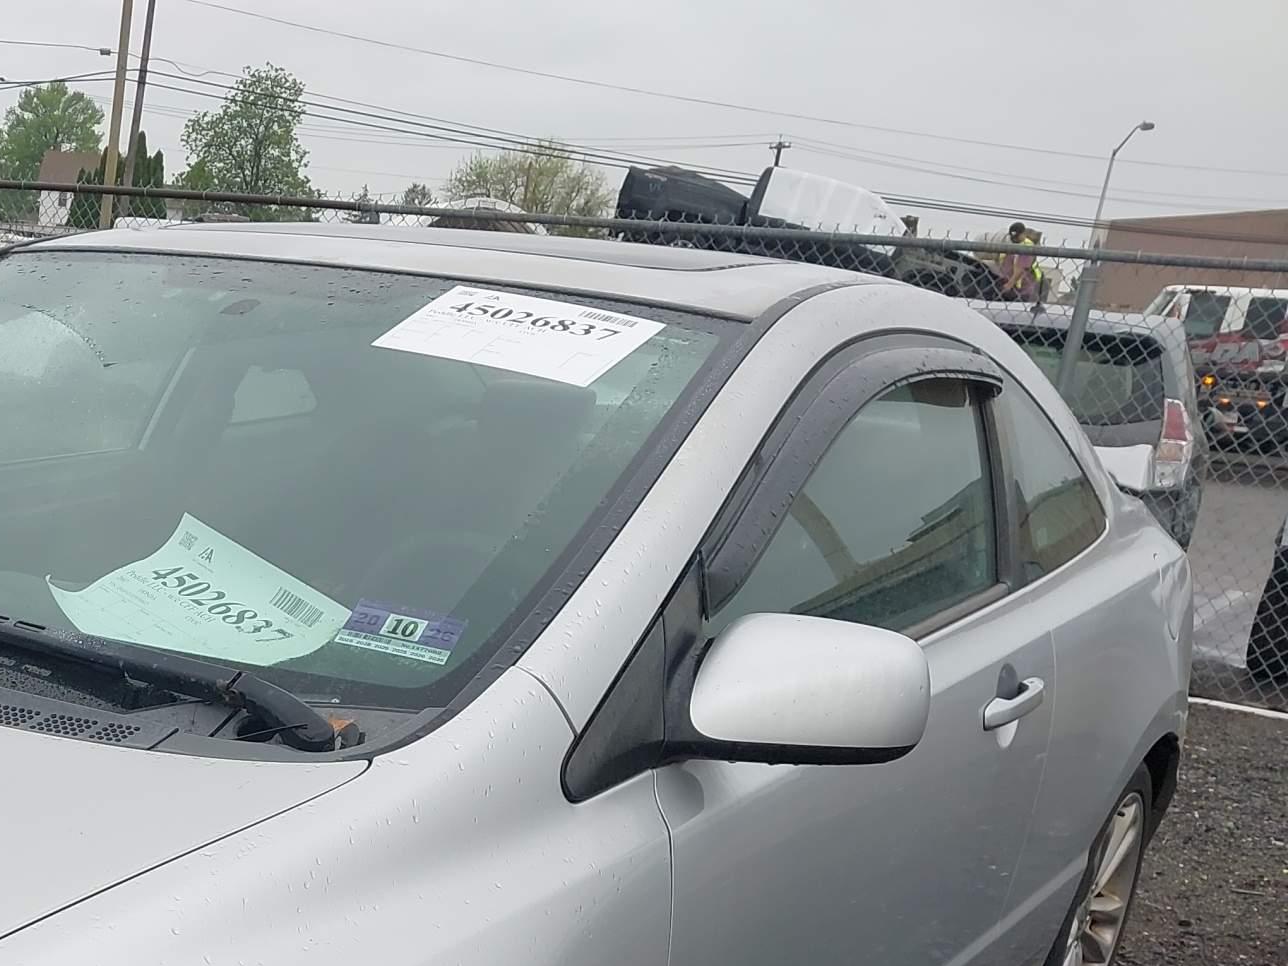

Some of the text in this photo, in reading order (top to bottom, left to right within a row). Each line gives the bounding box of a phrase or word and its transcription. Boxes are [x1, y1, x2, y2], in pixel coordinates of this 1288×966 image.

[449, 301, 623, 341] 45026837
[151, 566, 294, 643] 45026837
[353, 612, 456, 643] 20 10 26
